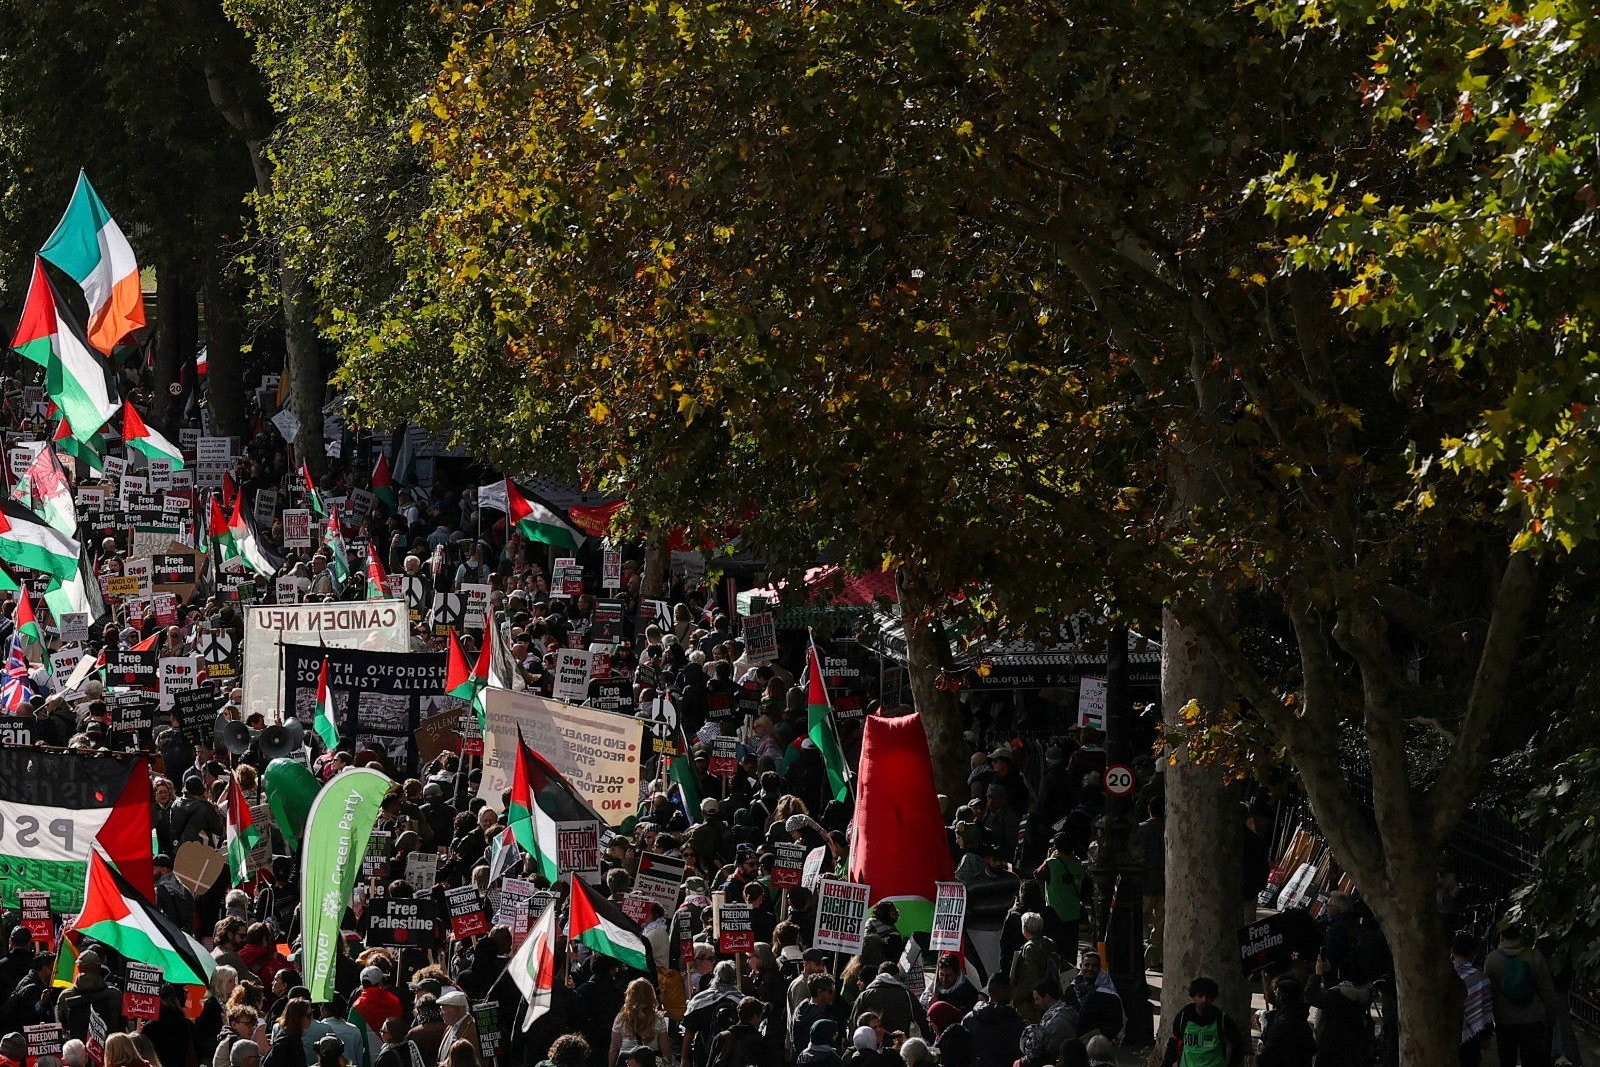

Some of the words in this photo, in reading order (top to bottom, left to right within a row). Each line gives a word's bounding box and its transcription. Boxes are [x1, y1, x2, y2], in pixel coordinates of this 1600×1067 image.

[138, 496, 154, 504] Free
[125, 514, 141, 522] Free
[162, 514, 178, 522] Free
[165, 556, 183, 564] Free
[128, 566, 146, 575] Stop
[155, 565, 194, 574] Palestine
[227, 574, 244, 584] Free
[746, 636, 774, 647] PROTEST
[54, 657, 78, 668] Stop
[118, 653, 141, 663] Free
[563, 655, 587, 667] Stop
[825, 656, 848, 666] Free
[107, 662, 153, 674] Palestine
[166, 665, 190, 674] Stop
[298, 659, 352, 674] NOTH
[367, 665, 447, 678] OXFORDSH
[560, 666, 587, 677] Arming
[164, 677, 193, 685] Arming
[560, 674, 584, 685] Israel
[982, 674, 1035, 684] foa.org.uk
[599, 686, 620, 697] Free
[118, 696, 140, 704] FREEDOM
[195, 702, 212, 712] SUDAN
[122, 709, 141, 719] Free
[113, 719, 151, 731] Palestine
[1108, 773, 1131, 786] 20
[338, 788, 364, 831] Party
[558, 830, 598, 850] FREEDOM
[776, 848, 802, 858] FREEDOM
[331, 836, 350, 882] Green
[558, 850, 598, 868] PALESTINE
[774, 860, 802, 869] PALESTINE
[638, 881, 652, 891] Say
[824, 883, 852, 898] DEFEND
[853, 888, 866, 901] THE
[23, 898, 47, 908] FREEDOM
[449, 892, 477, 904] FREEDOM
[387, 901, 418, 915] Free
[451, 903, 480, 916] PALESTINE
[821, 896, 850, 916] RIGHT
[852, 901, 864, 917] TO
[22, 910, 49, 920] PALESTINE
[721, 910, 750, 920] FREEDOM
[370, 914, 434, 931] Palestine
[721, 922, 752, 931] PALESTINE
[819, 913, 862, 934] PROTEST
[935, 915, 961, 931] PROTEST
[1248, 923, 1271, 938] Free
[1241, 932, 1285, 958] Palestine
[314, 929, 330, 980] Tower
[130, 970, 160, 982] FREEDOM
[126, 982, 160, 996] PALESTINE
[28, 1032, 59, 1042] FREEDOM
[28, 1044, 62, 1055] PALESTINE
